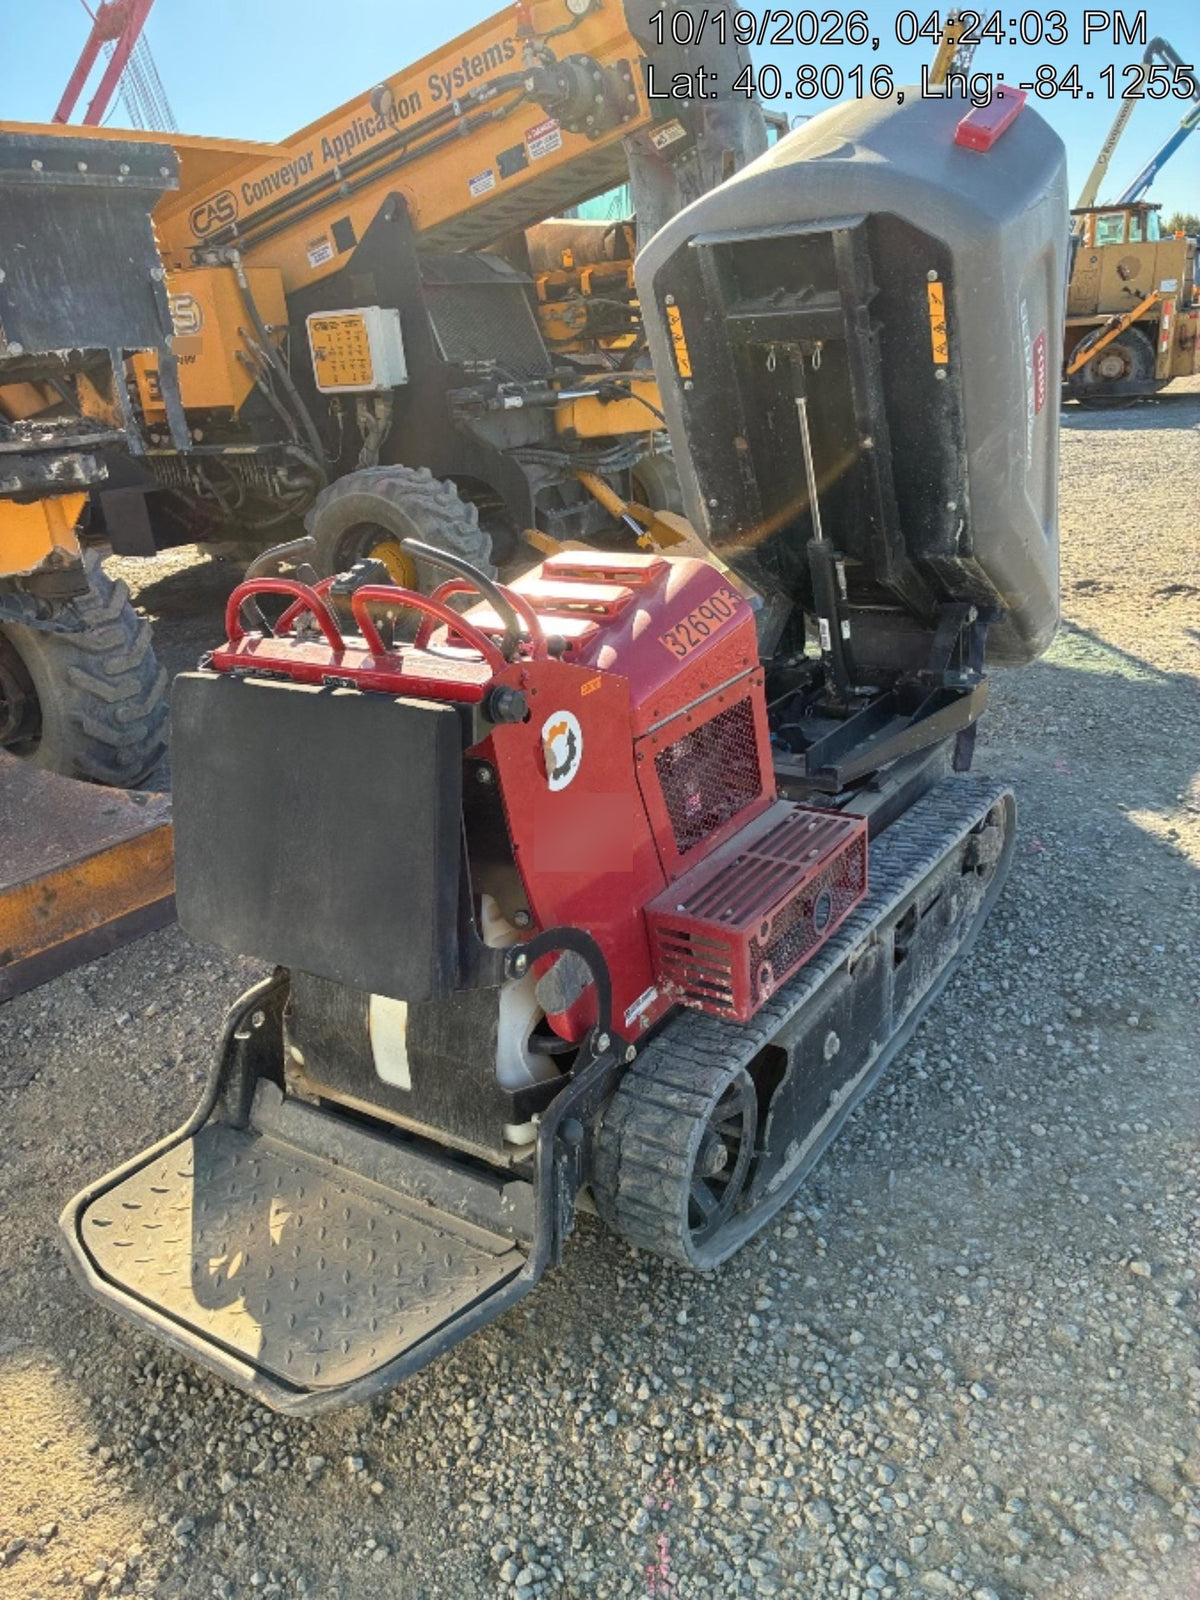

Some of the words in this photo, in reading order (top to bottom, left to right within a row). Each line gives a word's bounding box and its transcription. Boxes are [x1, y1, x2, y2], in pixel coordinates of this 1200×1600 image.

[193, 194, 236, 233] CAS
[241, 150, 314, 206] Conveyor
[320, 90, 422, 164] Application
[428, 35, 516, 103] Systems
[664, 587, 740, 657] 326903
